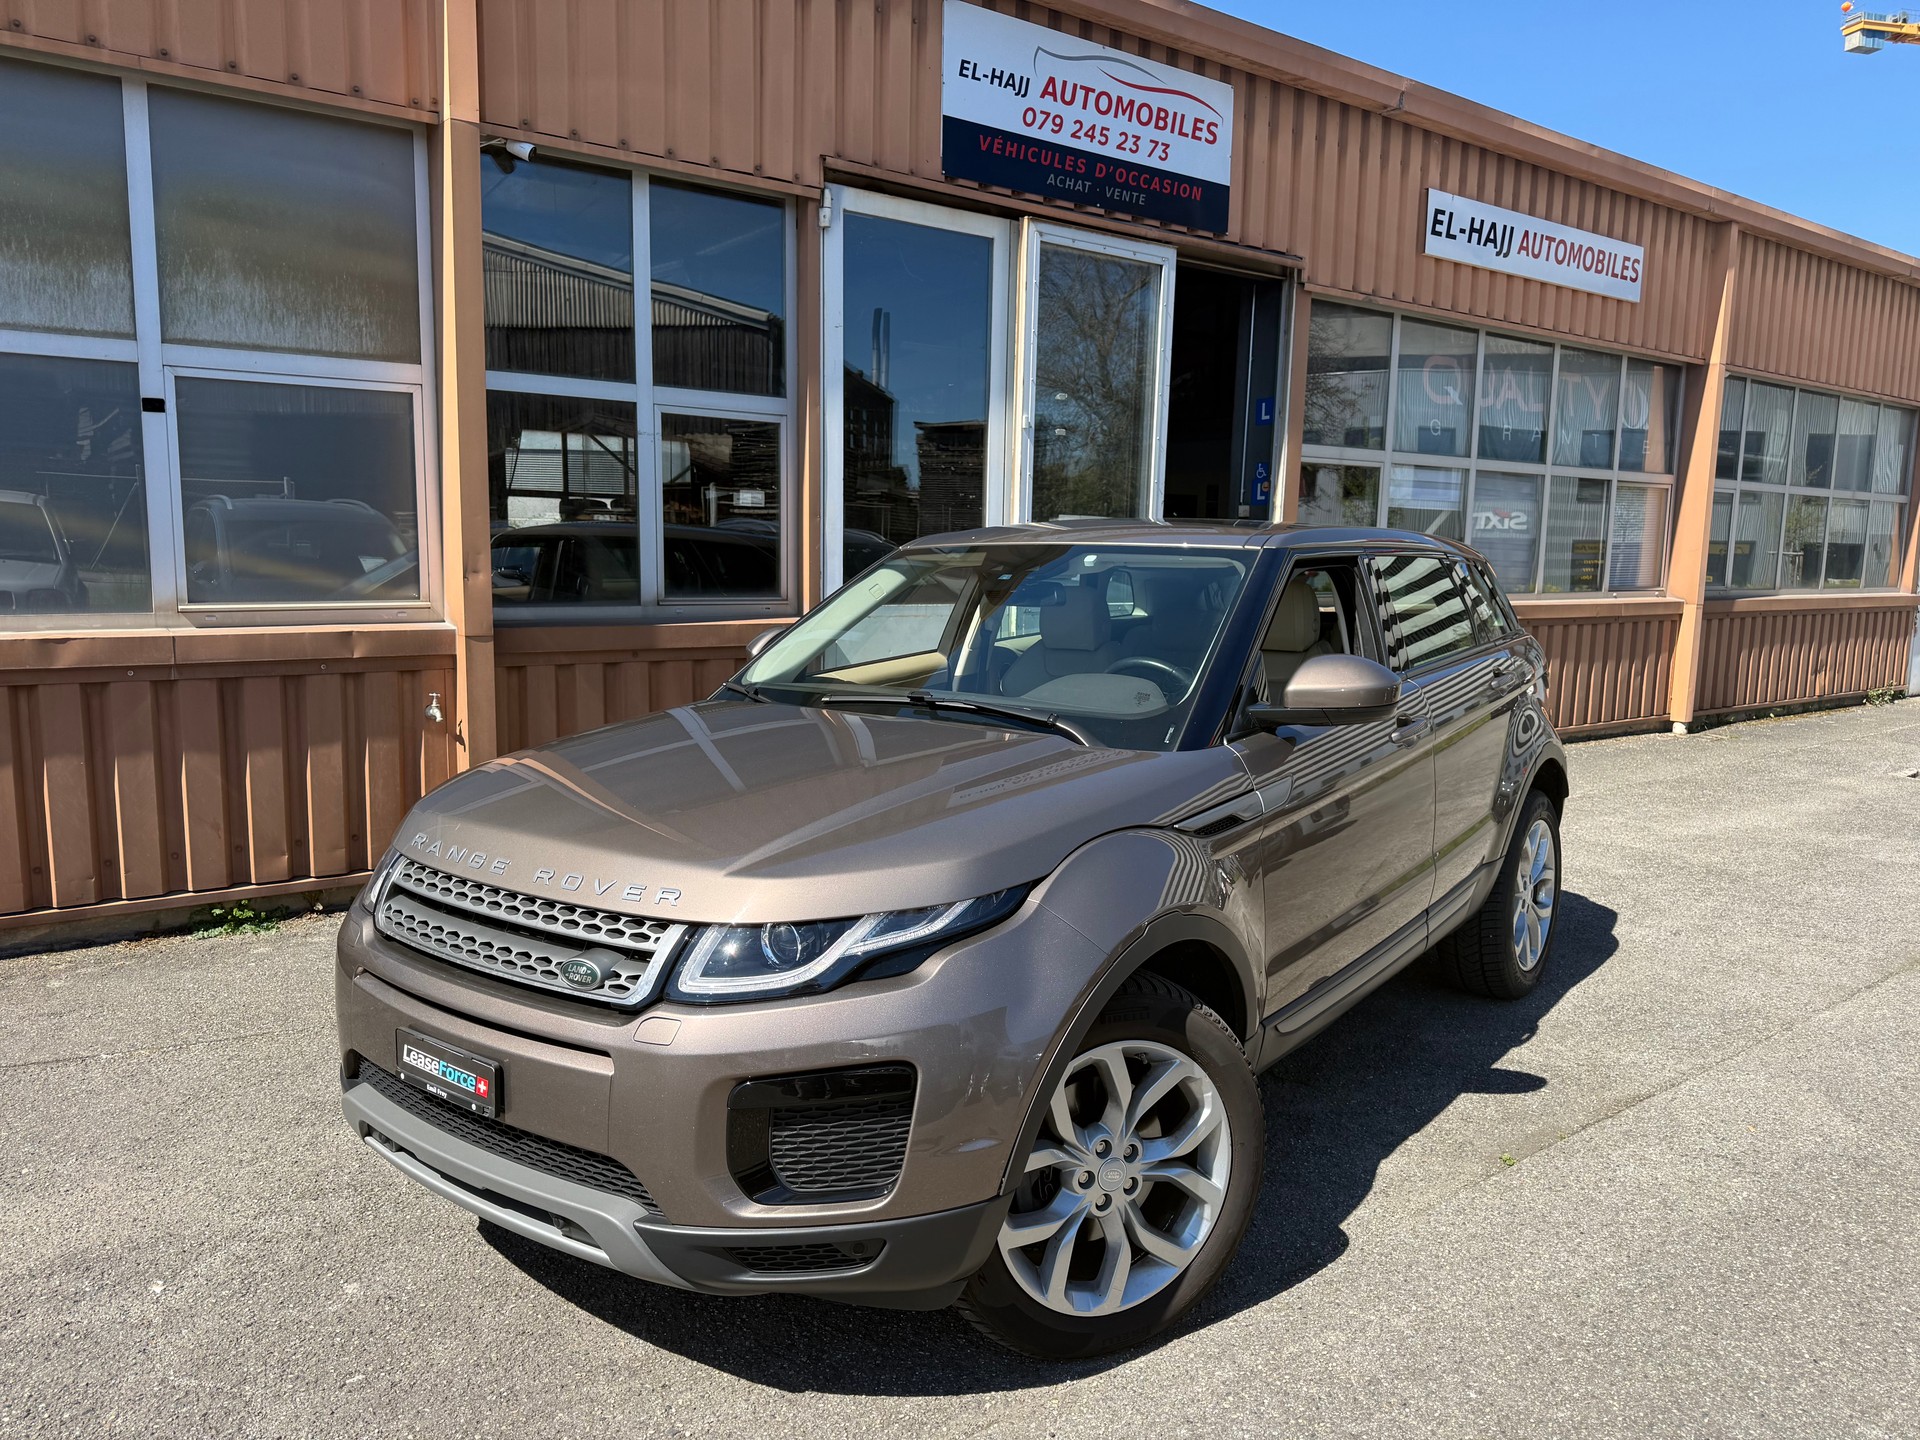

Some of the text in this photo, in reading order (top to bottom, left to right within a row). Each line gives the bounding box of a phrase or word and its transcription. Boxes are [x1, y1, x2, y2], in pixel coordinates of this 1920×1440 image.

[958, 59, 1219, 145] EL-HAJJ AUTOMOBILES
[1022, 107, 1171, 162] 079 245 23 73
[979, 135, 1202, 201] VÉHICULES D'OCCASION
[1046, 174, 1146, 206] ACHAT VENTE
[1430, 207, 1641, 283] EL-HAJJ AUTOMOBILES
[1261, 402, 1270, 420] L
[411, 832, 683, 907] RANGE ROVER
[567, 965, 587, 975] LAND
[568, 972, 592, 983] ROVER
[402, 1044, 476, 1091] LeaseForce
